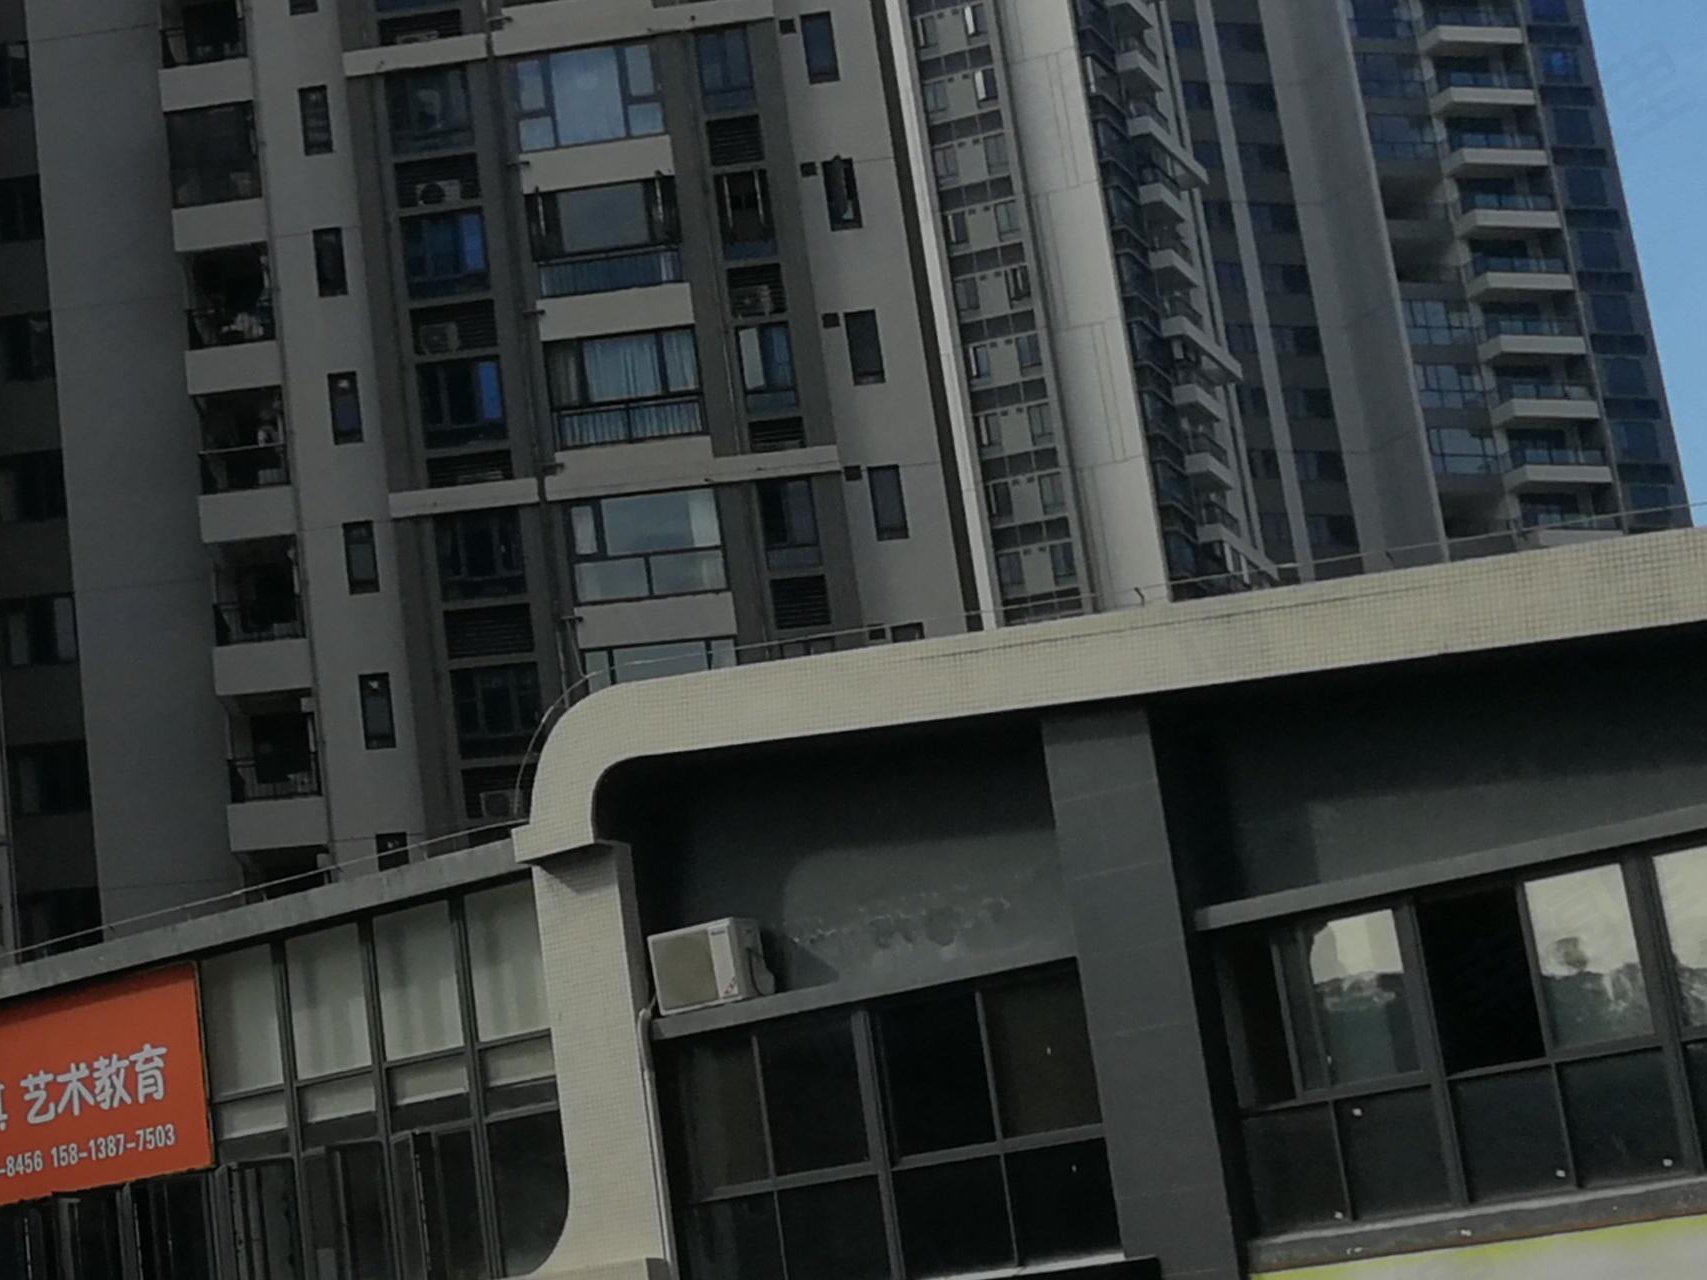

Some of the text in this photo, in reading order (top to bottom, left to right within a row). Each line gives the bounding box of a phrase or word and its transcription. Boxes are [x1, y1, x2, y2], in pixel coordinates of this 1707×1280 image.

[20, 1044, 167, 1124] 艺术教育
[51, 1124, 176, 1167] 158-1387-7503
